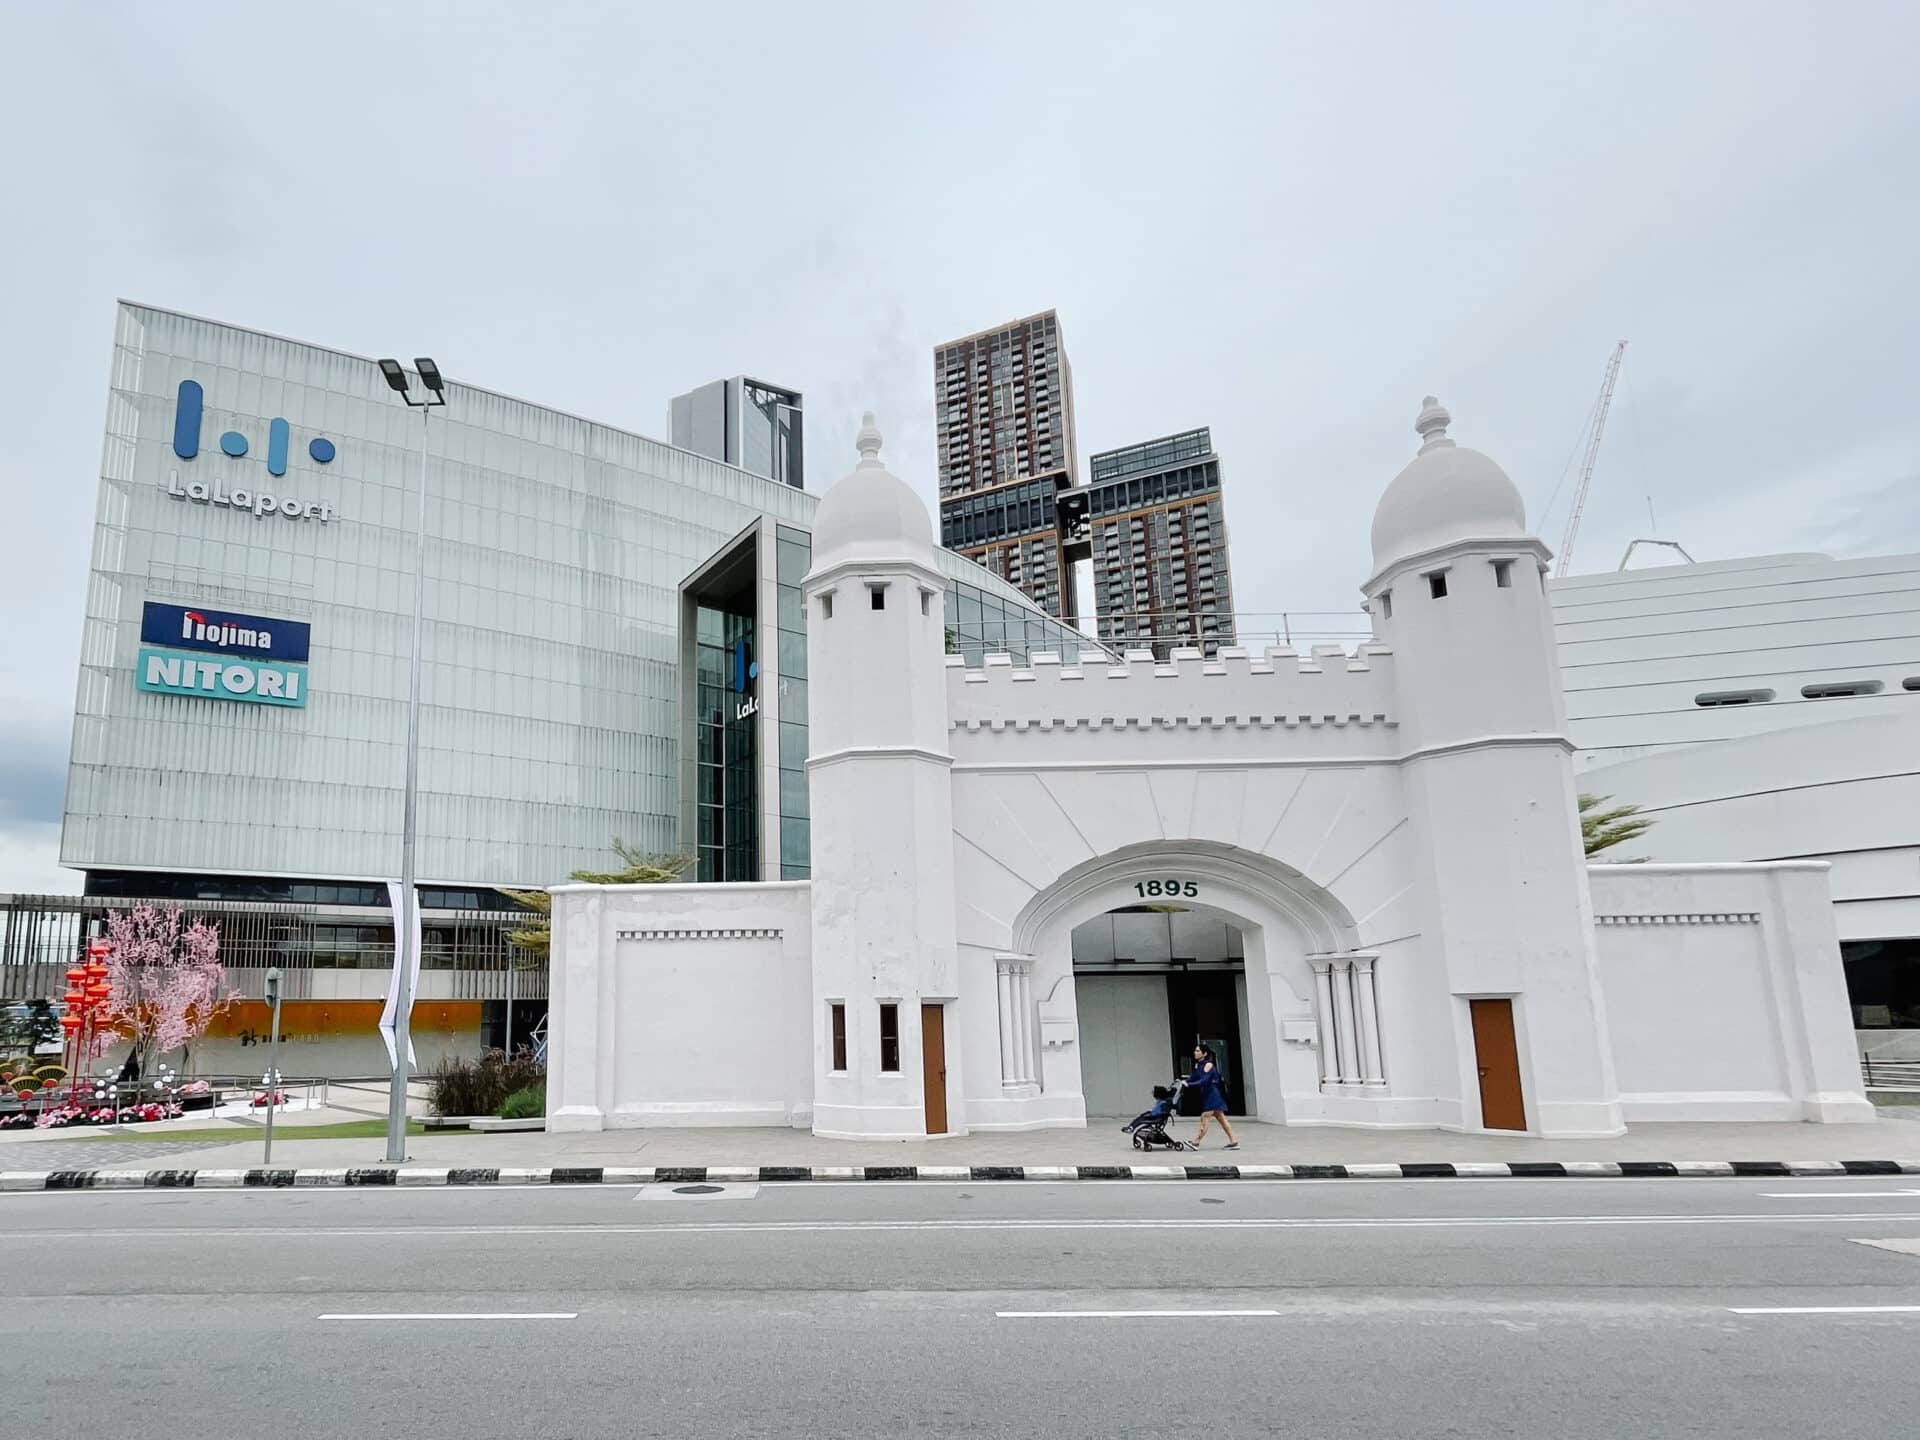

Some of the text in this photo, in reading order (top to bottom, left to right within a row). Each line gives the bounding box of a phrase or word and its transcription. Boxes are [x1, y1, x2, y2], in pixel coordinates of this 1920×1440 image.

[167, 470, 332, 522] LaLaport
[182, 611, 271, 648] nojima
[146, 656, 299, 700] NITORI
[1134, 880, 1198, 898] 1895
